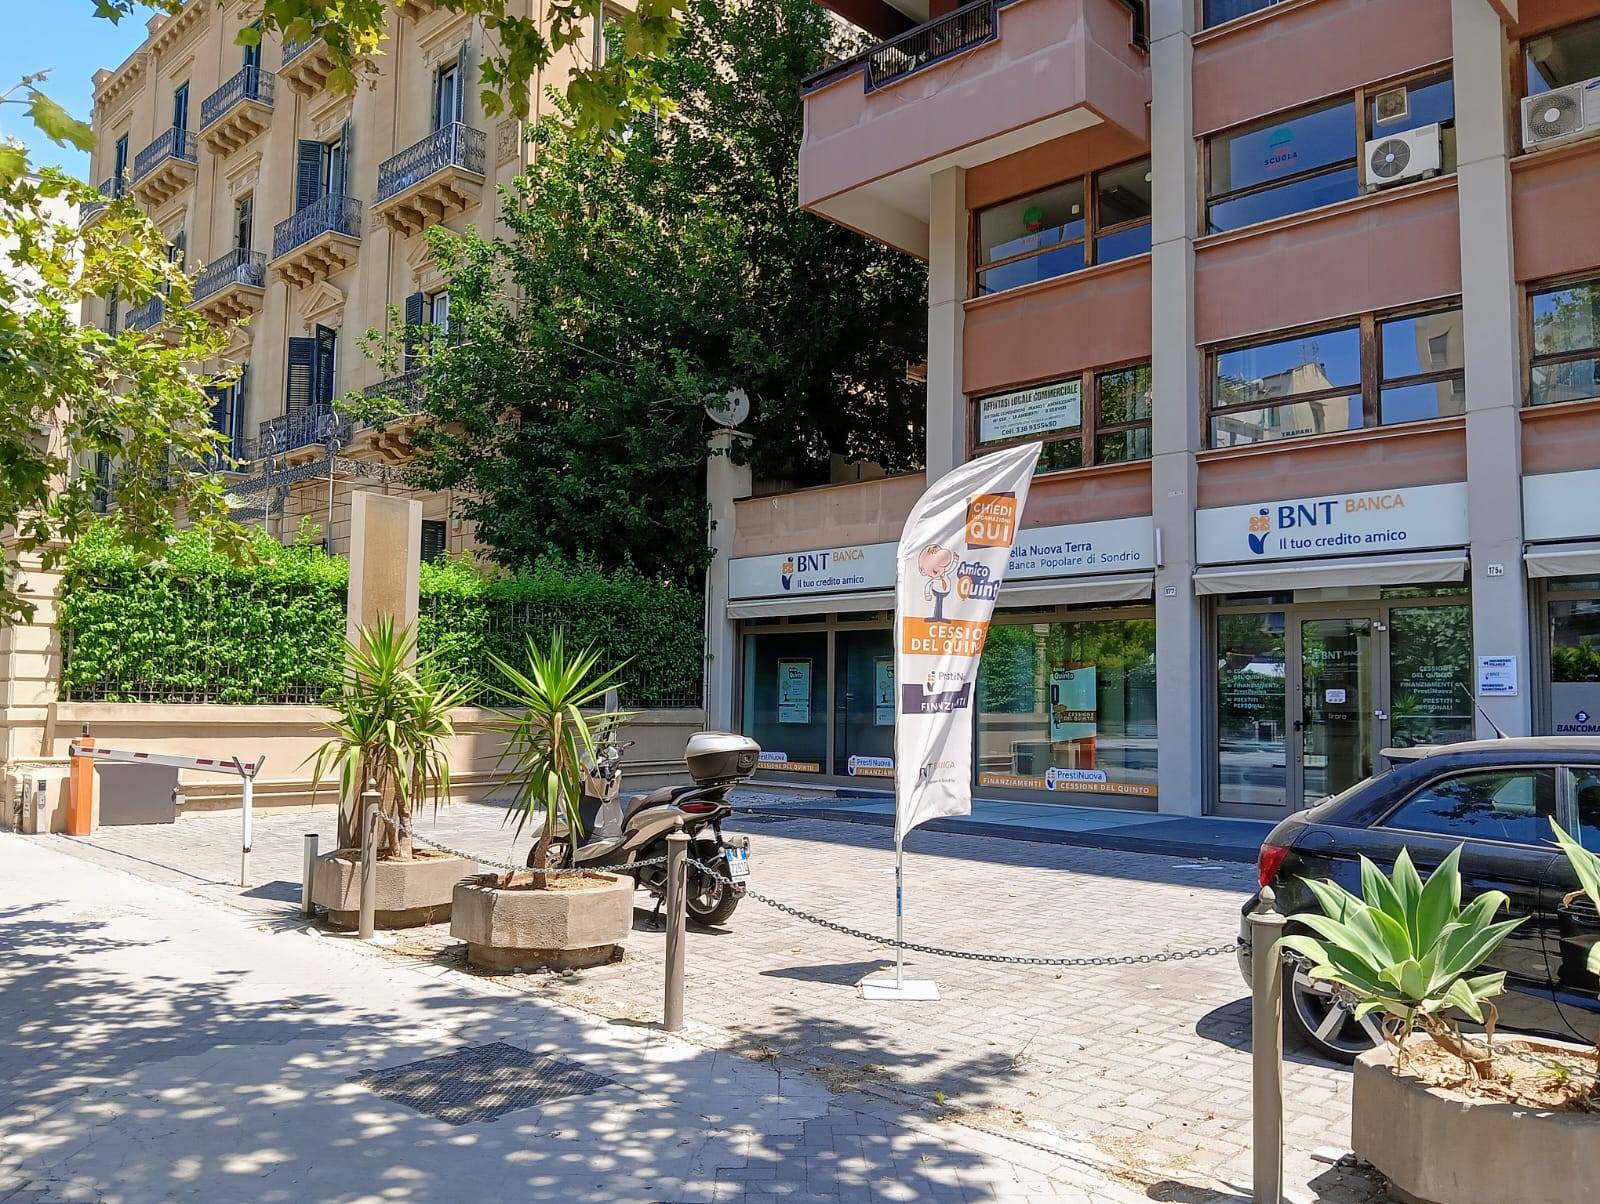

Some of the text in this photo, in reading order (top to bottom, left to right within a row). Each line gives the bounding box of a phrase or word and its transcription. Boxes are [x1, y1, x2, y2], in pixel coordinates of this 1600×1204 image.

[1264, 152, 1297, 165] SCUOLA
[1011, 393, 1032, 406] LOCALE
[1033, 383, 1078, 401] COMMERCIALE
[973, 502, 1012, 517] CHIEDI
[1278, 494, 1405, 529] BNT BANCA
[970, 521, 1009, 542] QUI
[1290, 538, 1311, 549] tuo
[1315, 533, 1361, 547] credito
[1365, 530, 1407, 543] amico
[1009, 542, 1092, 557] ella Nuova Terra
[797, 550, 865, 572] BNT BANCA
[1009, 551, 1140, 570] Banca Popolare di Sondrio
[958, 563, 989, 577] Amico
[803, 579, 815, 588] tuo
[816, 576, 841, 587] credito
[842, 574, 865, 585] amico
[956, 576, 1000, 600] Quint
[929, 625, 985, 641] CESSIO
[911, 638, 938, 652] DEL
[1321, 650, 1342, 660] BNT
[1556, 724, 1600, 733] BANCOMA
[857, 759, 891, 768] PrestiNuova
[859, 768, 895, 777] FINANZIAM
[1057, 770, 1103, 781] PrestiNuova
[983, 776, 1042, 788] FINANZIAMENTI
[1060, 782, 1150, 794] CESSIONE DEL QUINTO
